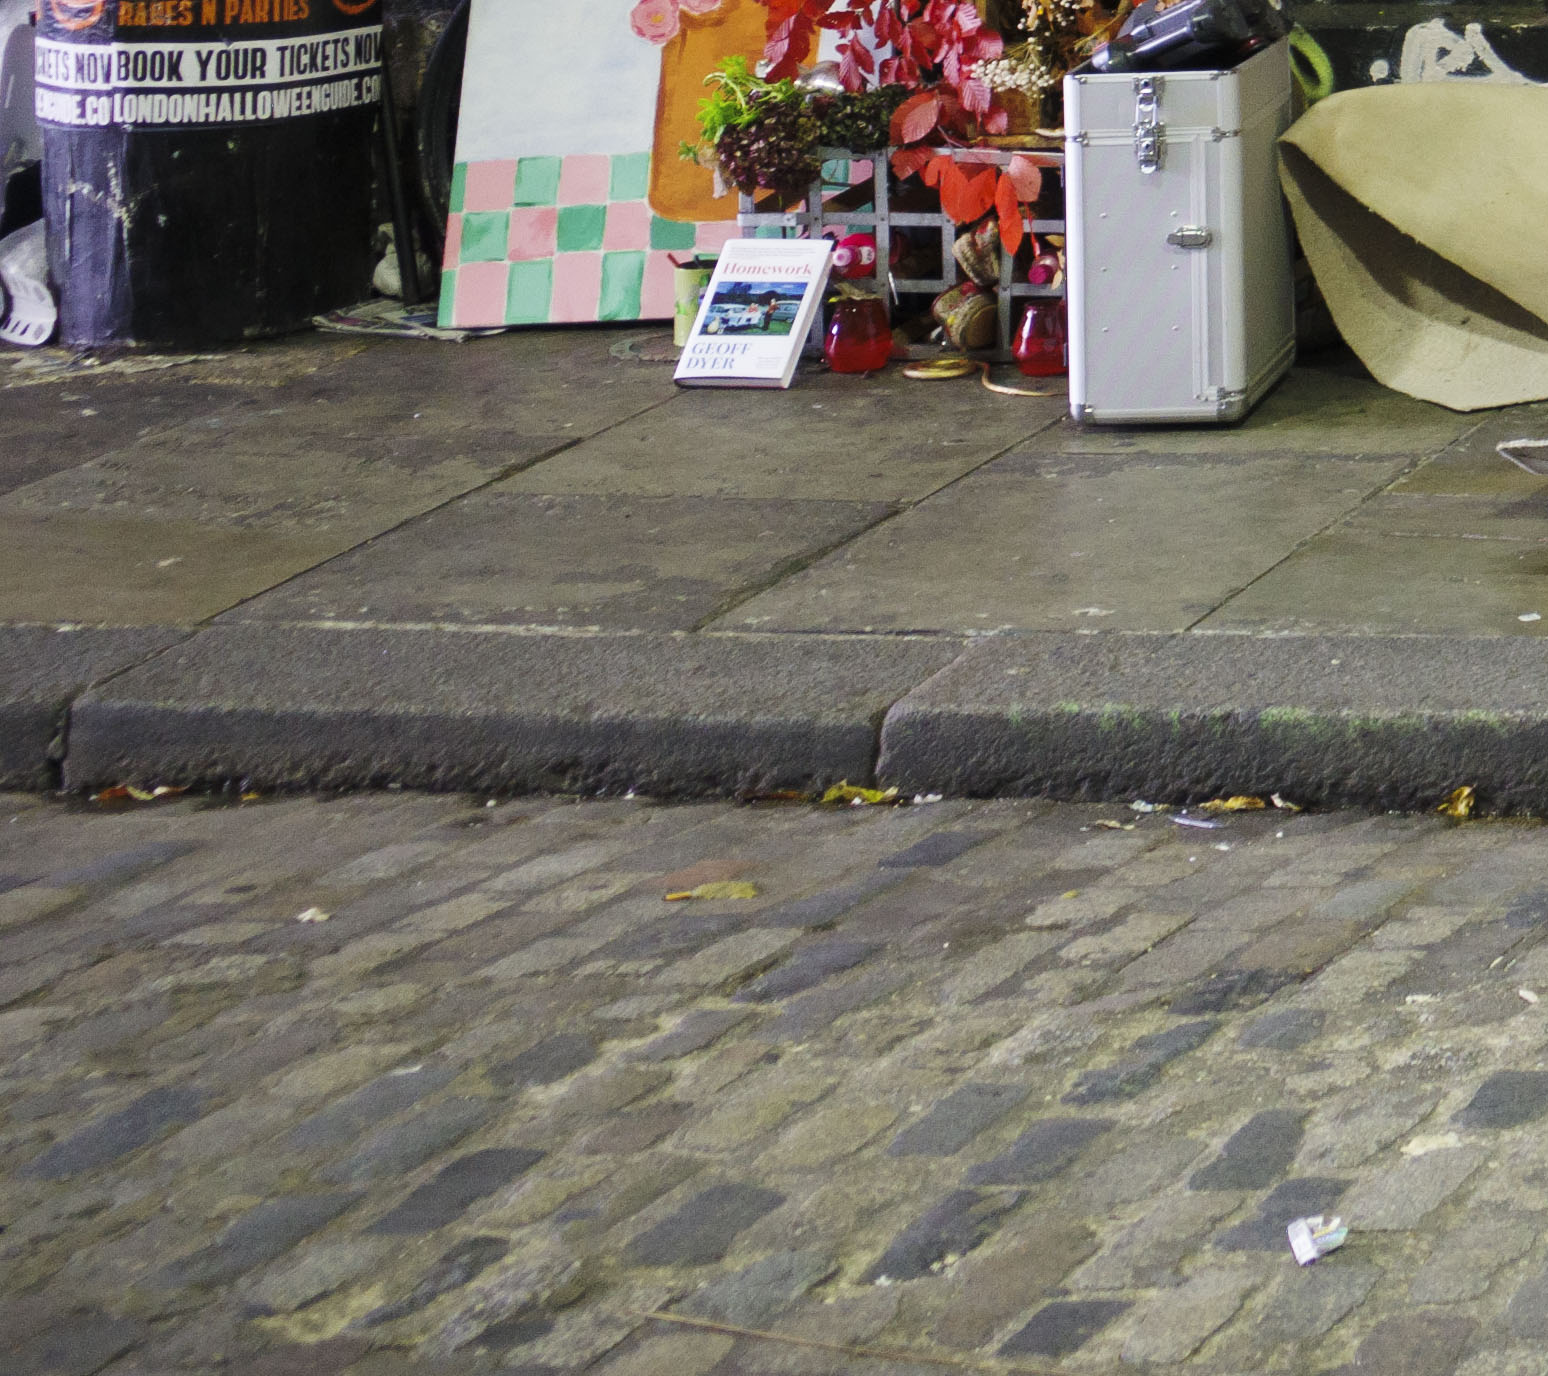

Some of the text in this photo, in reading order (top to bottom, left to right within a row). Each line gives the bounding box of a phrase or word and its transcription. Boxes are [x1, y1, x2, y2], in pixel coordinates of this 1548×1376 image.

[201, 2, 216, 25] N
[117, 50, 183, 82] BOOK
[195, 47, 267, 82] YOUR
[277, 37, 349, 77] TICKETS
[113, 74, 381, 124] LONDONHALLOWEENGUIDE.CO
[722, 263, 813, 275] Homework
[691, 342, 752, 355] GEOFF
[686, 357, 735, 370] DYER
